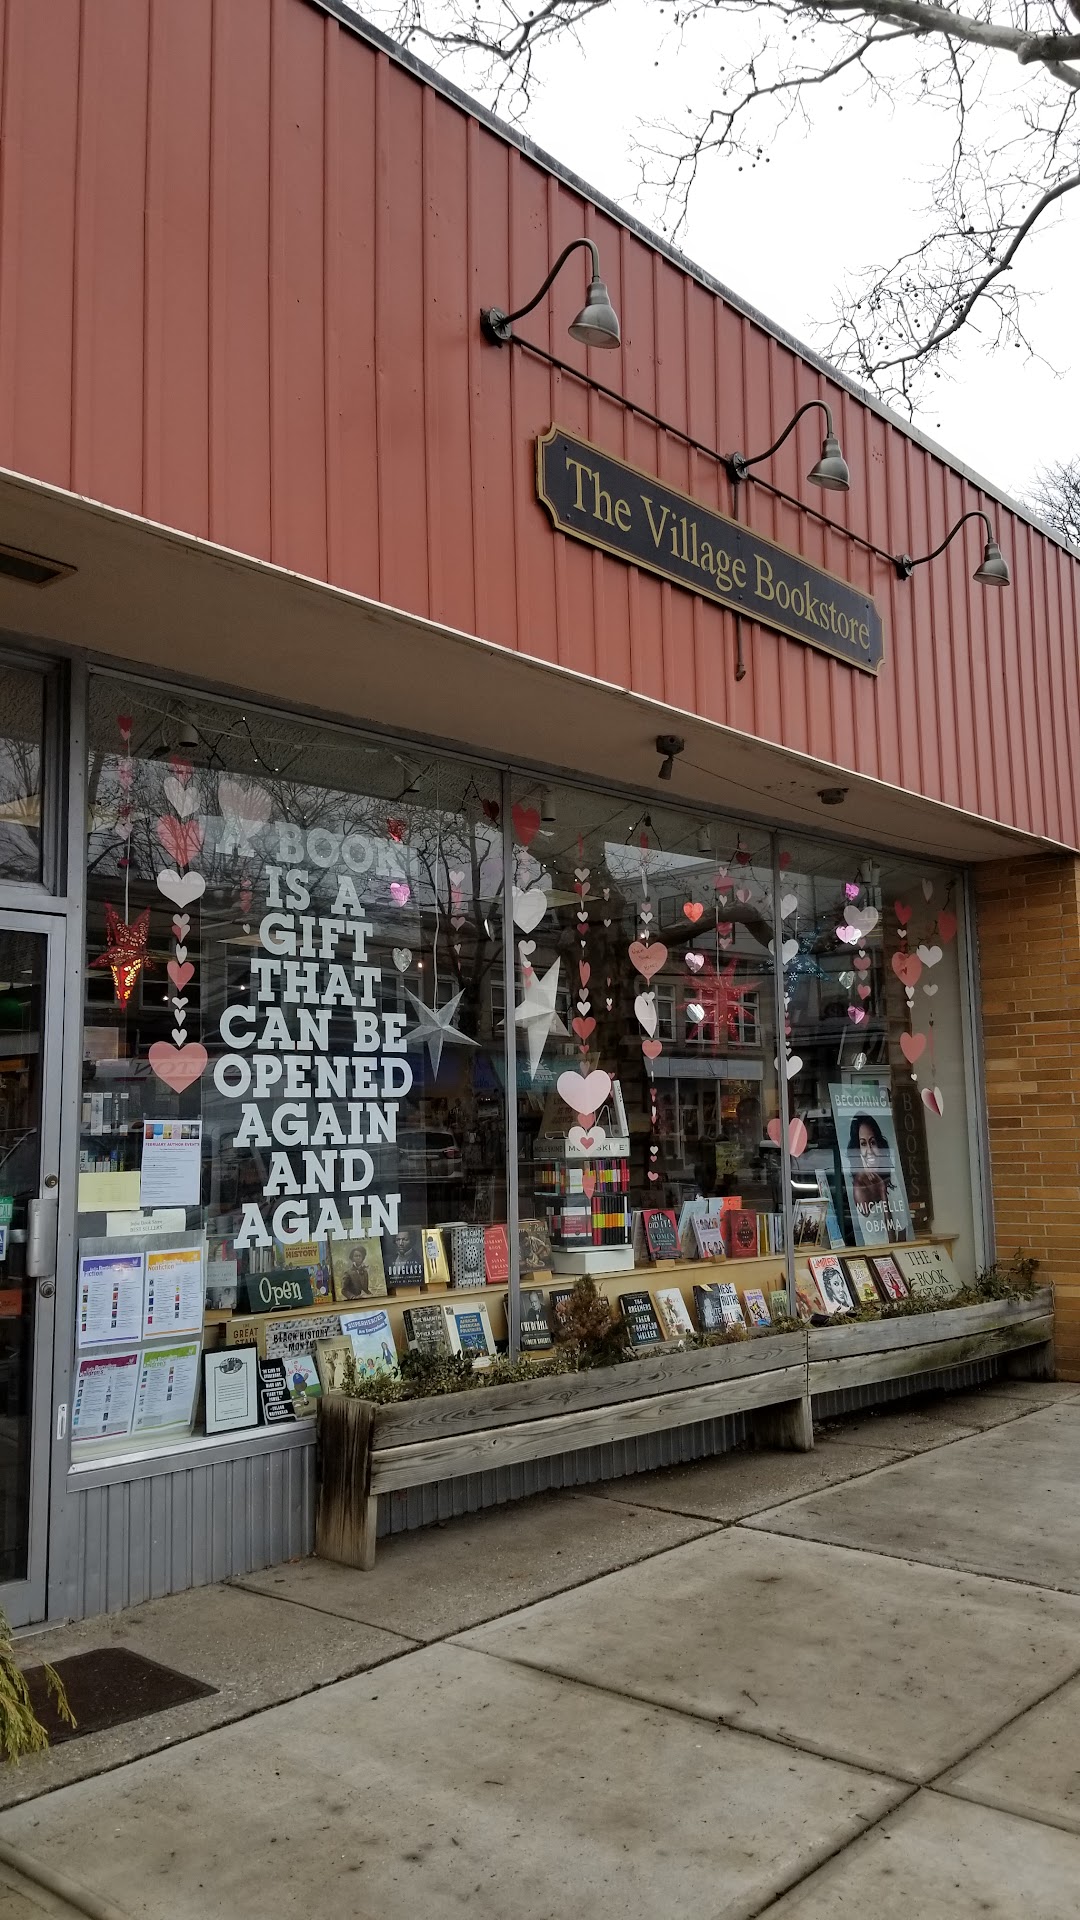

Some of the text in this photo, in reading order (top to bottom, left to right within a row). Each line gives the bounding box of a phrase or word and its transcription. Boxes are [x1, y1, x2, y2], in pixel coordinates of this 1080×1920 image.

[565, 456, 871, 650] The Village Bookstore
[275, 821, 407, 878] BOOK
[265, 865, 366, 917] IS A
[259, 912, 374, 962] GIFT
[250, 958, 382, 1007] THAT
[219, 1004, 408, 1053] CAN BE
[213, 1053, 413, 1098] OPENED
[834, 1094, 888, 1107] BECOMING
[233, 1102, 400, 1147] AGAIN
[902, 1092, 921, 1197] BOOKS
[263, 1149, 375, 1197] AND
[233, 1193, 401, 1249] AGAIN
[648, 1221, 659, 1229] DID
[855, 1200, 905, 1214] MICHELLE
[865, 1218, 903, 1233] OBAMA
[285, 1249, 318, 1259] HISTORY
[388, 1265, 422, 1276] DOUGLASS
[905, 1250, 932, 1266] THE
[259, 1276, 303, 1306] Open
[916, 1269, 949, 1286] BOOK
[233, 1327, 258, 1338] GREAT
[273, 1328, 330, 1344] BLACK HISTORY
